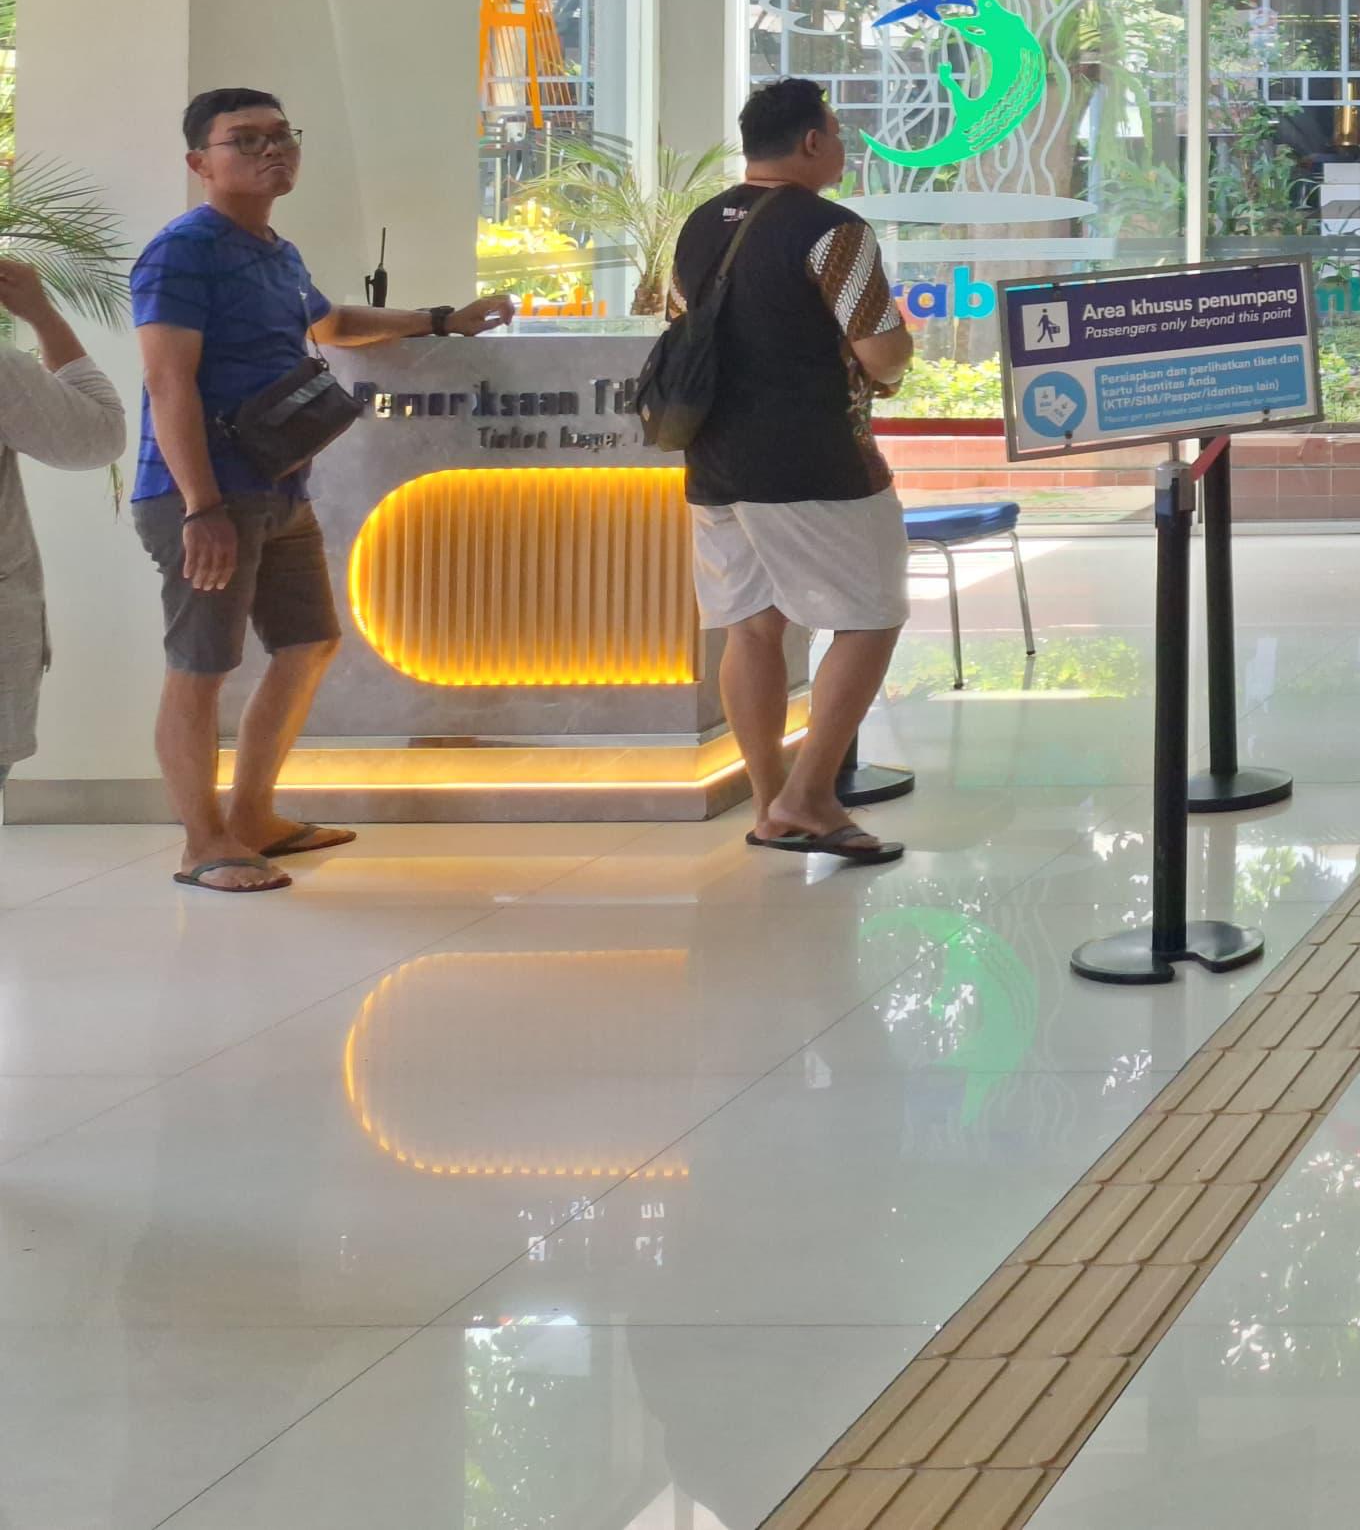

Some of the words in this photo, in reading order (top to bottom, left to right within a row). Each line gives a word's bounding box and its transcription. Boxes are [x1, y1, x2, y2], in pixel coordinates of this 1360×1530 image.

[1082, 303, 1125, 321] Area
[1131, 298, 1193, 317] khusus
[1198, 288, 1298, 313] penumpang
[1085, 323, 1157, 340] Passengers
[1160, 317, 1187, 333] only
[1190, 312, 1235, 330] beyond
[1239, 309, 1259, 323] this
[1262, 307, 1293, 322] point
[1101, 370, 1163, 385] Persiapkan
[1166, 367, 1188, 378] dan
[1190, 359, 1251, 378] perlihatkan
[1253, 355, 1278, 367] tiket
[1280, 354, 1300, 365] dan
[1256, 378, 1280, 391] lain)
[1101, 386, 1132, 398] kartu
[1135, 380, 1185, 393] identitas
[1188, 376, 1217, 387] Anda
